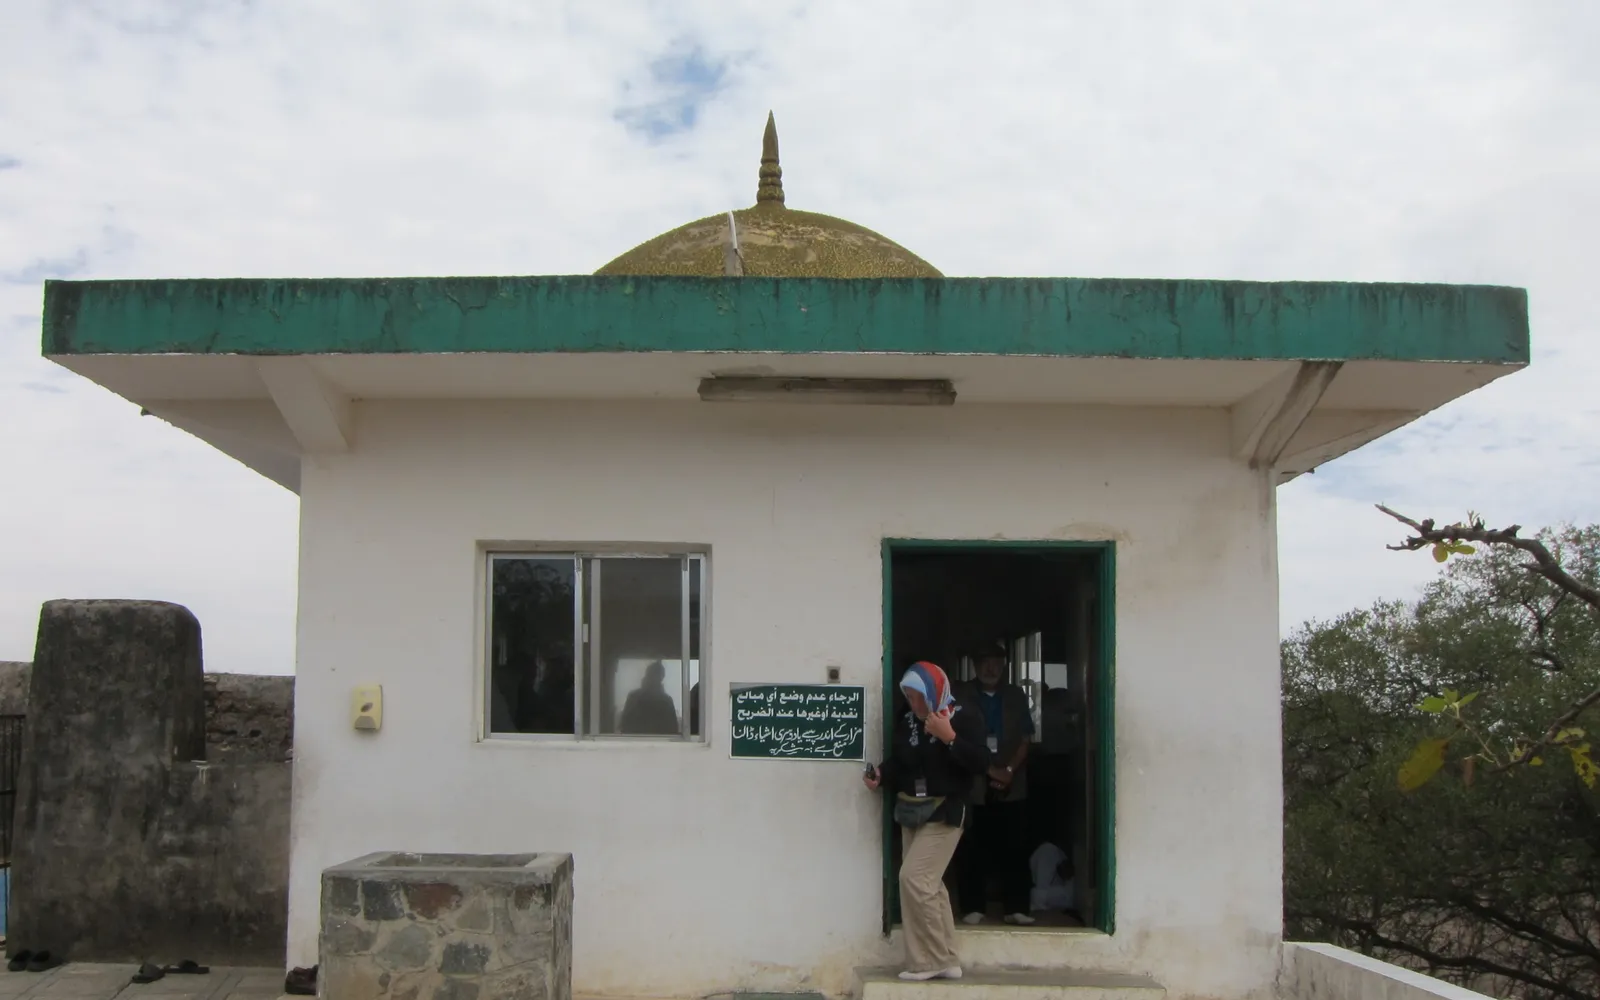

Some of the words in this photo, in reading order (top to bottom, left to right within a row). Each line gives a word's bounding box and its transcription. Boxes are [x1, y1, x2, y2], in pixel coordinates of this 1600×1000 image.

[766, 687, 777, 706] أي
[780, 690, 804, 704] وضع
[806, 693, 826, 705] عدم
[829, 692, 859, 704] الرجاء
[737, 707, 774, 721] الضريح
[776, 709, 795, 717] عند
[831, 706, 858, 722] نقدية
[732, 725, 754, 740] ڈالنا
[815, 727, 833, 740] اندر
[844, 727, 862, 745] مزار
[832, 740, 847, 757] منع
